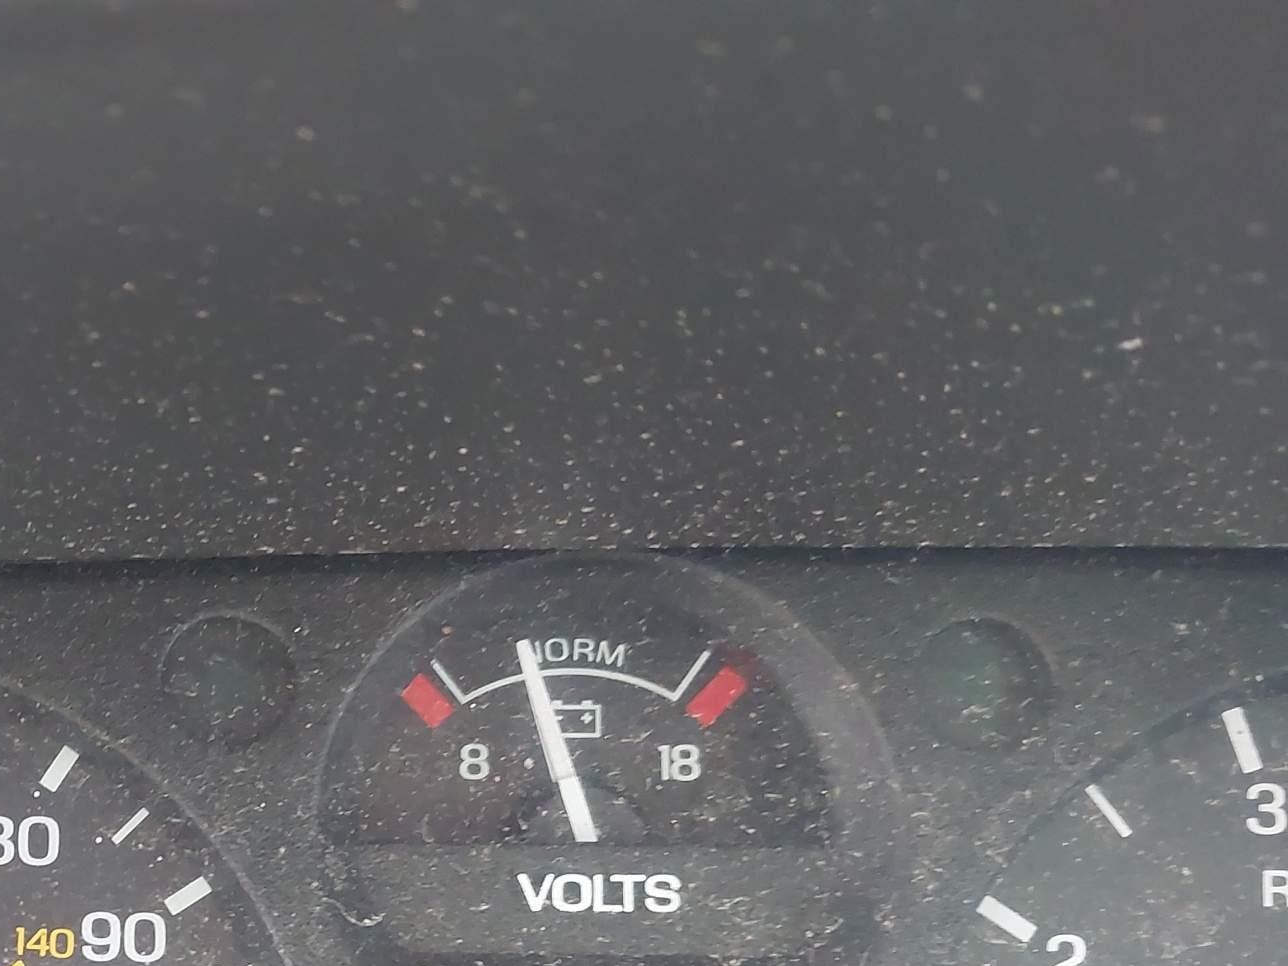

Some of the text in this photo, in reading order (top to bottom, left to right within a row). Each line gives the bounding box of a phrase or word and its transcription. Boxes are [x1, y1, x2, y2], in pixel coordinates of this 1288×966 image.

[457, 742, 492, 780] 8
[656, 743, 702, 782] 18
[1245, 782, 1288, 835] 3
[516, 872, 683, 913] VOLTS
[14, 927, 76, 960] 140
[80, 911, 167, 962] 90
